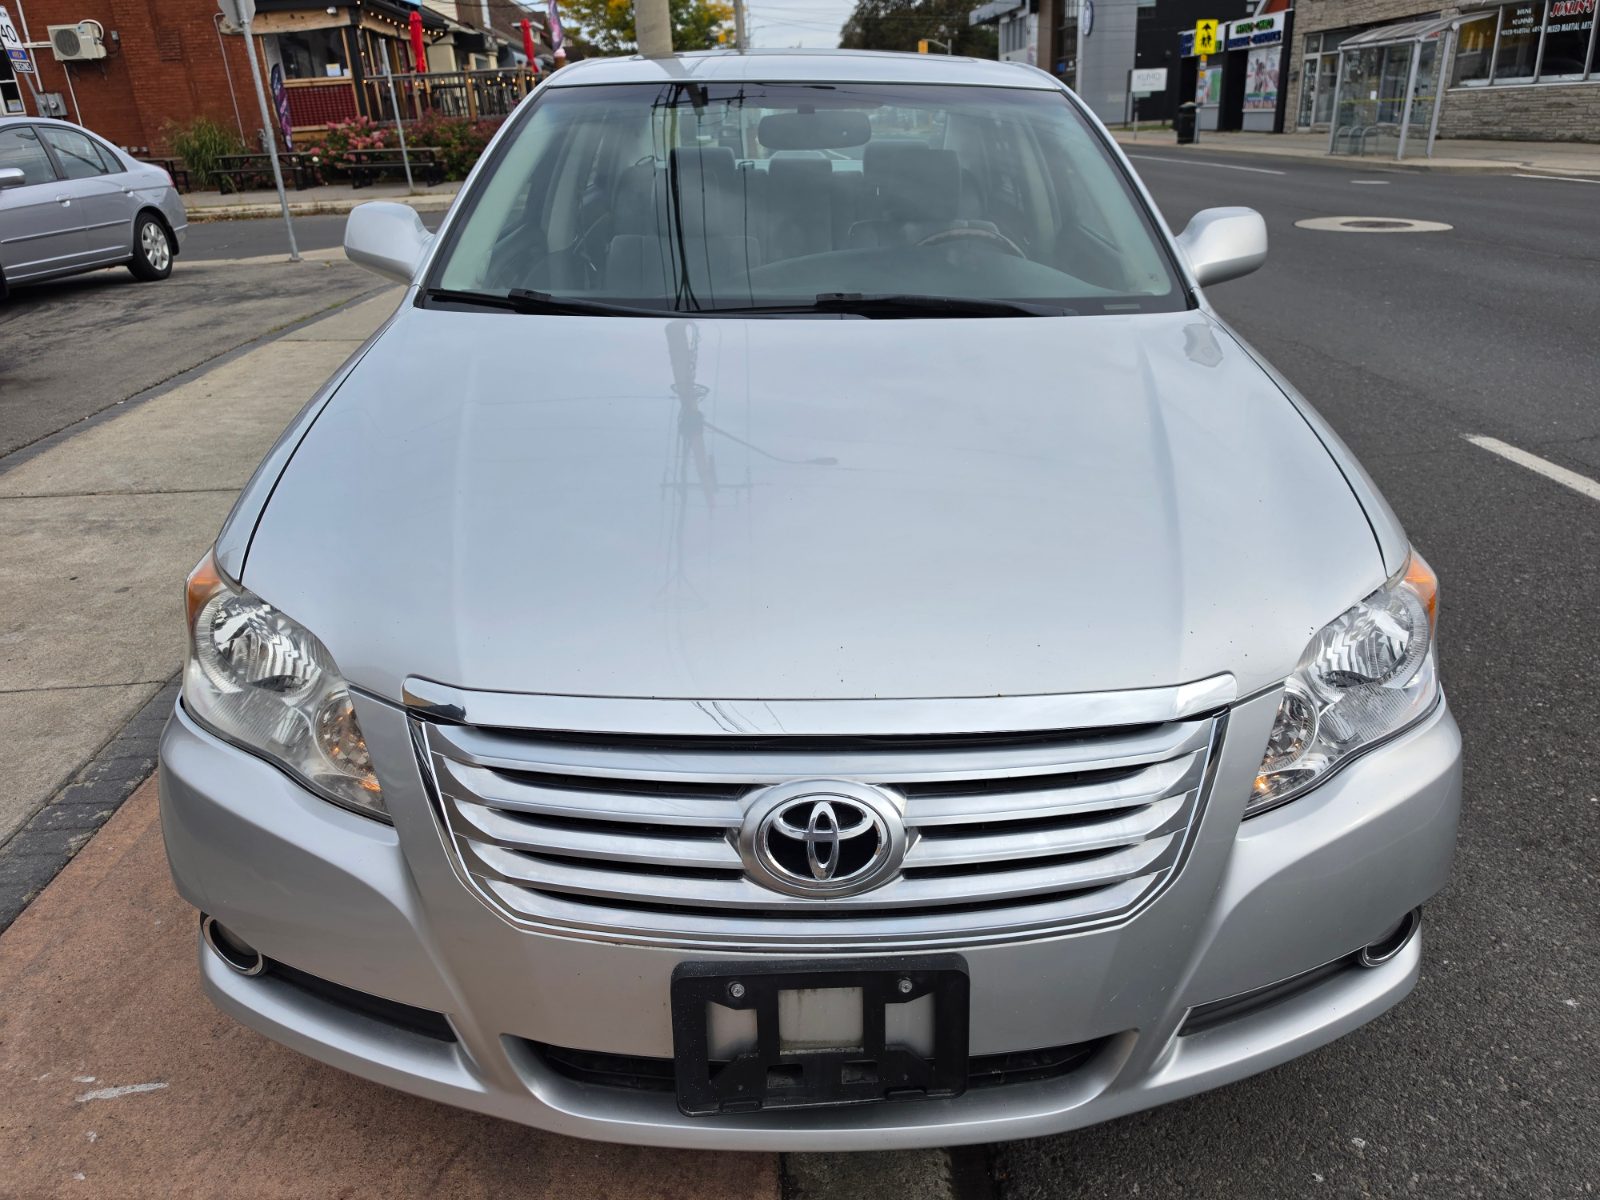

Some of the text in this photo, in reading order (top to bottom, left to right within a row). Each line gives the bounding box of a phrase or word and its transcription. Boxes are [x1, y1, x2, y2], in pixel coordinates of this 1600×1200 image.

[1, 24, 17, 43] 40
[1546, 20, 1593, 33] MIXED MARTIAL ARTS
